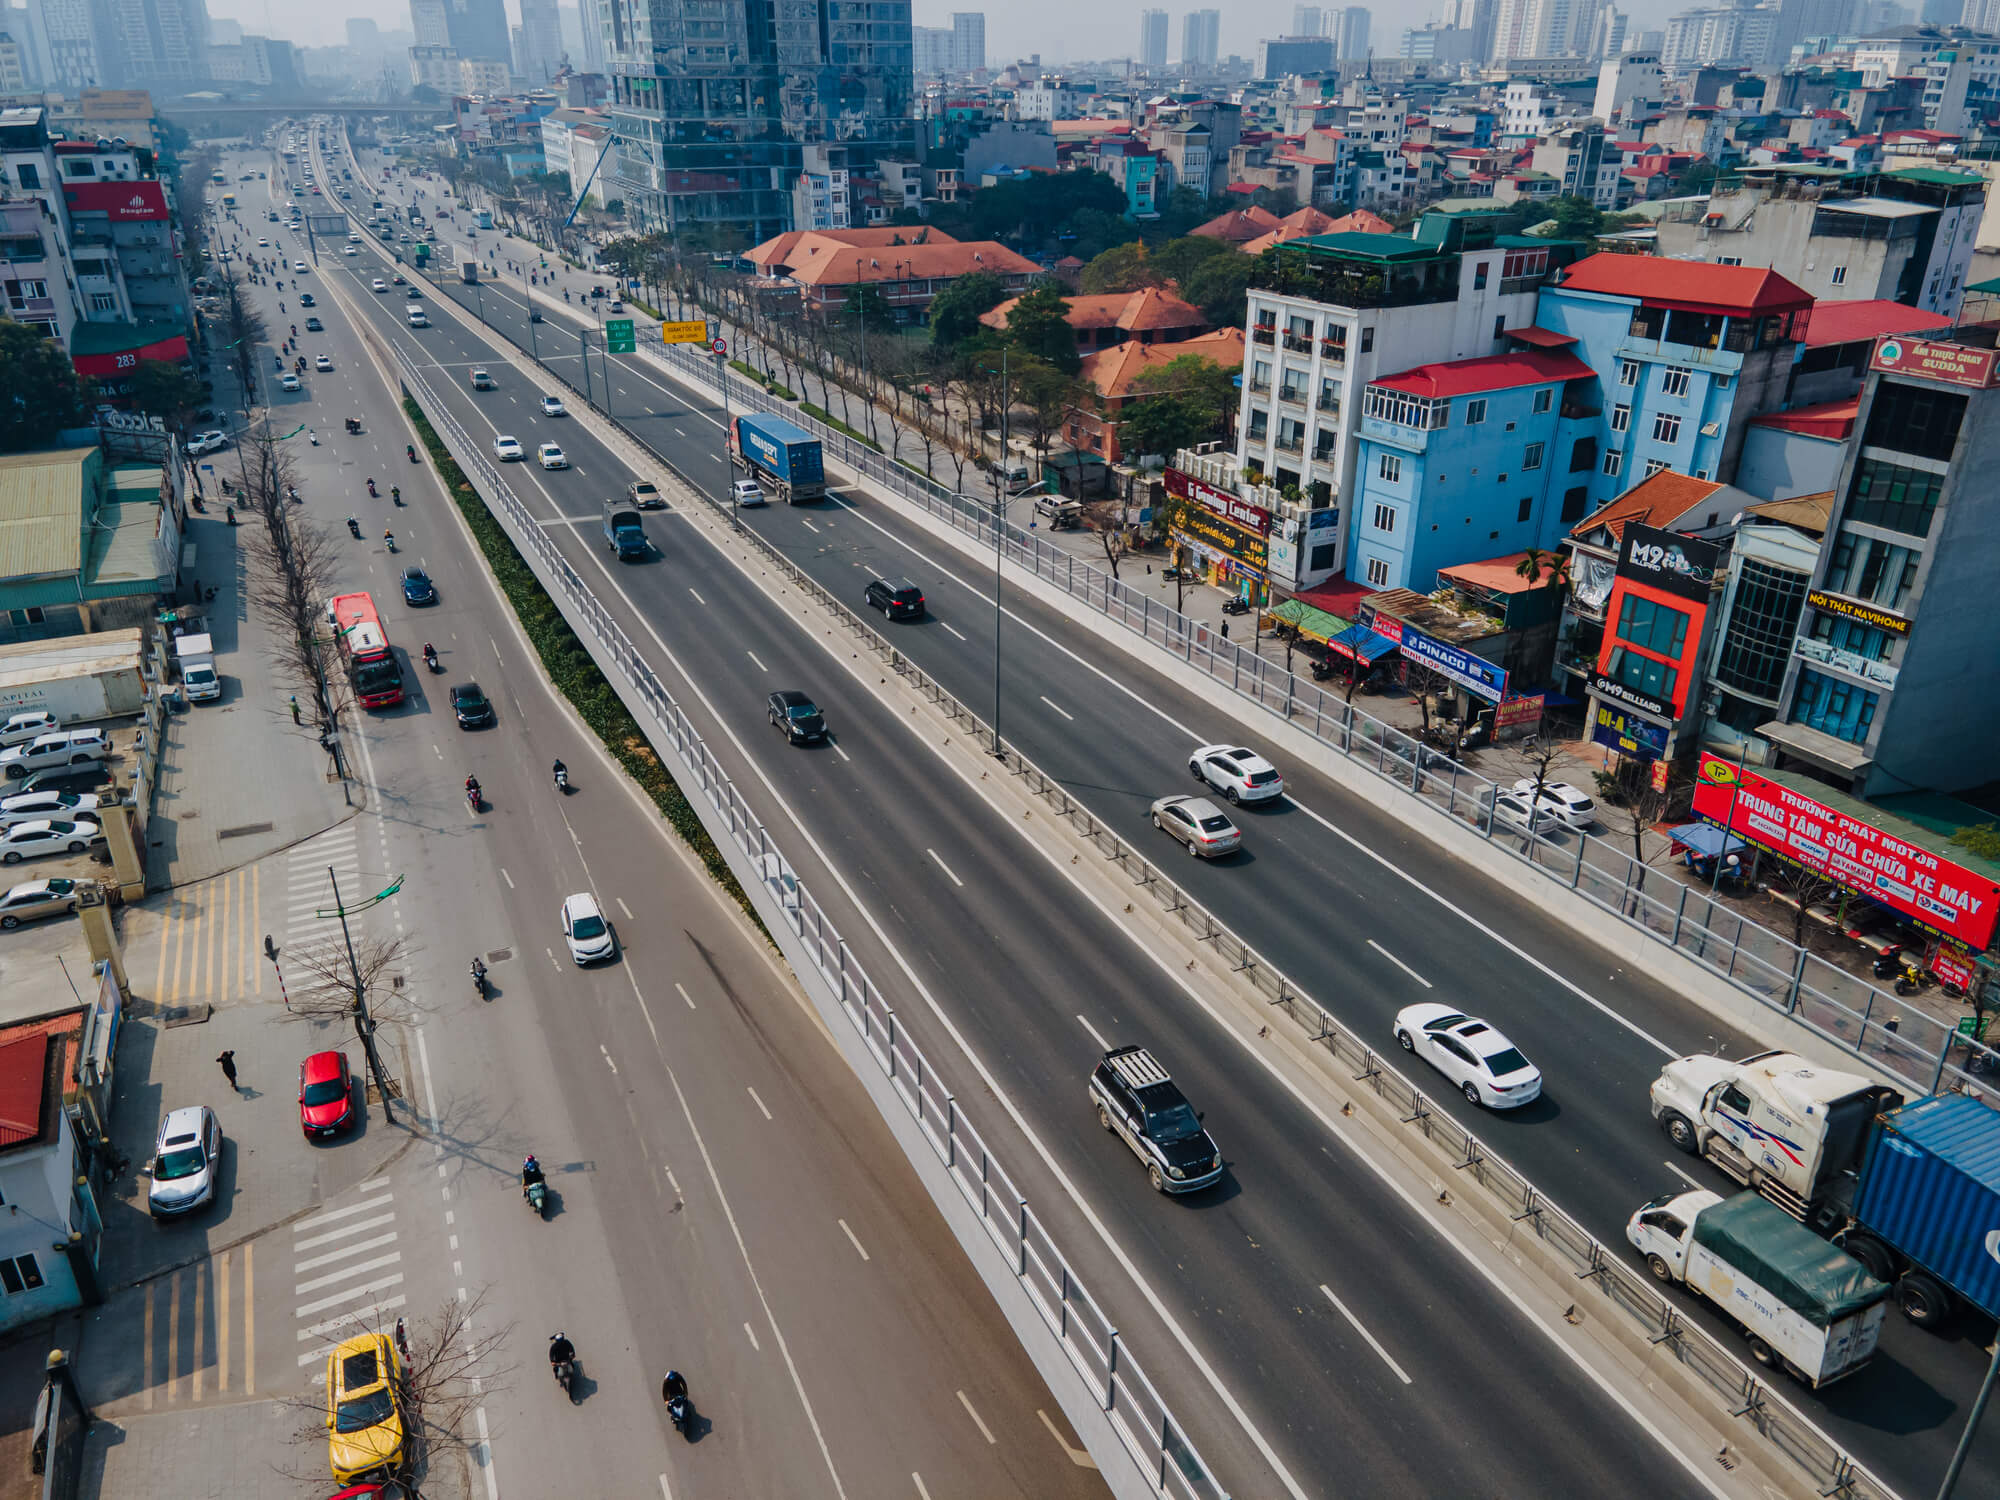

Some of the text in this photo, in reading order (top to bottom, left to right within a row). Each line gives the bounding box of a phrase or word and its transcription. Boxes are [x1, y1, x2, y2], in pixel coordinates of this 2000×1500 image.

[715, 342, 724, 351] 60
[115, 354, 136, 368] 283
[1228, 500, 1261, 527] Center
[1630, 540, 1664, 564] M9
[1853, 607, 1908, 632] NAVIHOME
[1418, 640, 1466, 671] PINACO
[2, 690, 46, 702] APITAL
[1738, 789, 1983, 915] TRUNG TÂM SỬA CHỮA XE MÁY
[1838, 817, 1878, 843] PHÁT
[1881, 836, 1938, 871] MOTOR
[1841, 859, 1872, 881] YAMAHA
[1931, 903, 1955, 920] SYM
